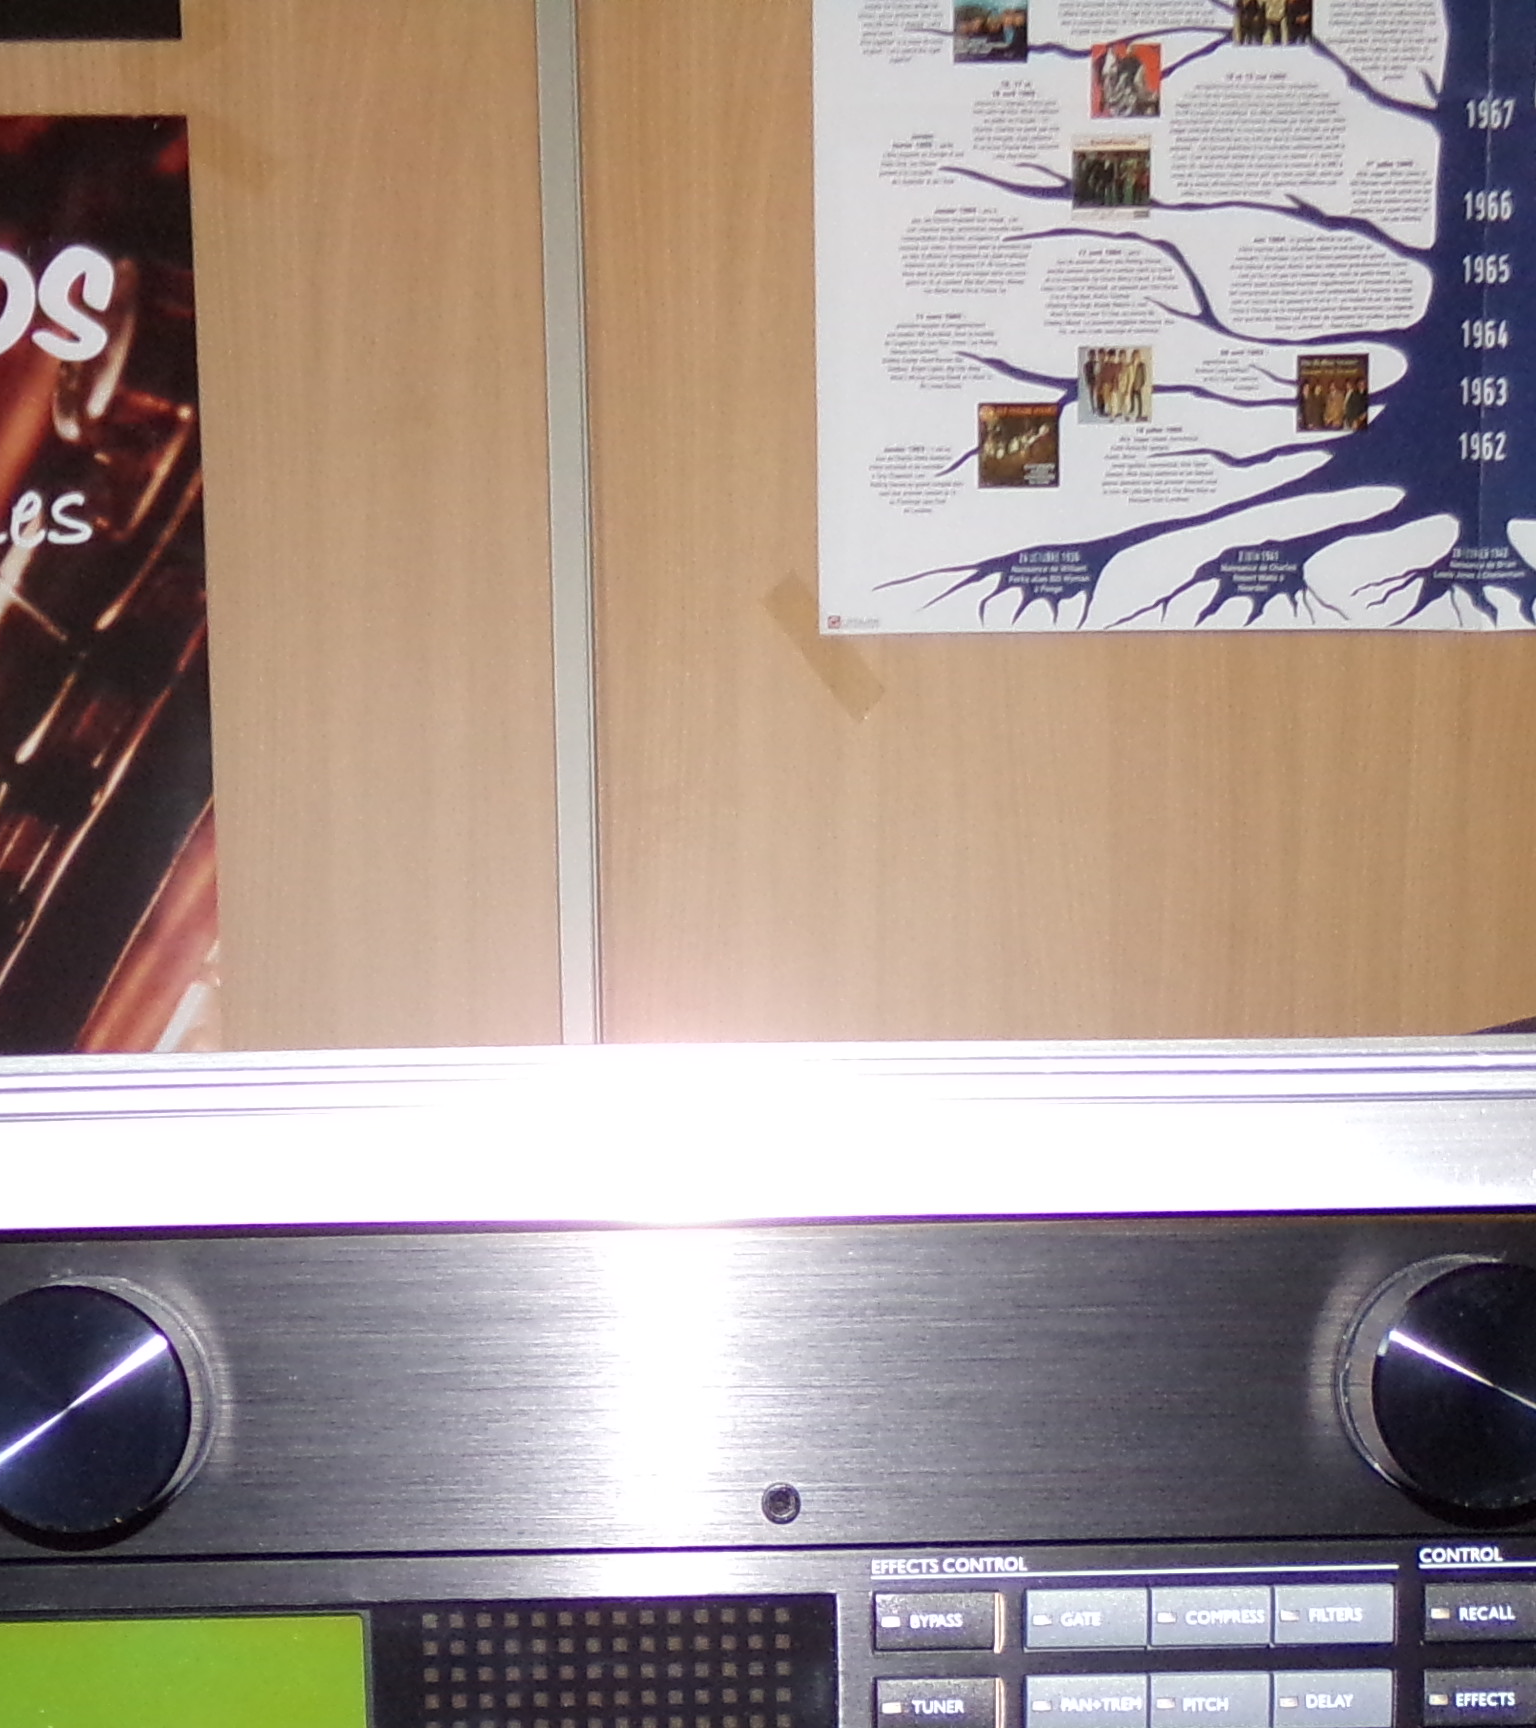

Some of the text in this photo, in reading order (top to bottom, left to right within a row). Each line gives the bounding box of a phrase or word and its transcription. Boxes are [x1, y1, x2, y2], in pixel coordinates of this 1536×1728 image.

[1466, 98, 1515, 130] 1967
[1464, 190, 1513, 221] 1966
[1463, 254, 1511, 285] 1965
[1461, 320, 1509, 350] 1964
[1459, 376, 1508, 407] 1963
[1458, 431, 1507, 461] 1962
[1419, 1546, 1504, 1563] CONTROL
[870, 1556, 1028, 1575] EFFECTS CONTROL
[909, 1613, 963, 1629] BYPASS
[1060, 1611, 1102, 1627] GATE
[1184, 1609, 1265, 1625] COMPRESS
[1308, 1607, 1363, 1623] FILTERS
[1458, 1606, 1516, 1621] RECALL
[911, 1699, 964, 1714] TUNER
[1182, 1696, 1229, 1712] PITCH
[1305, 1693, 1354, 1709] DELAY
[1455, 1692, 1515, 1707] EFFECTS
